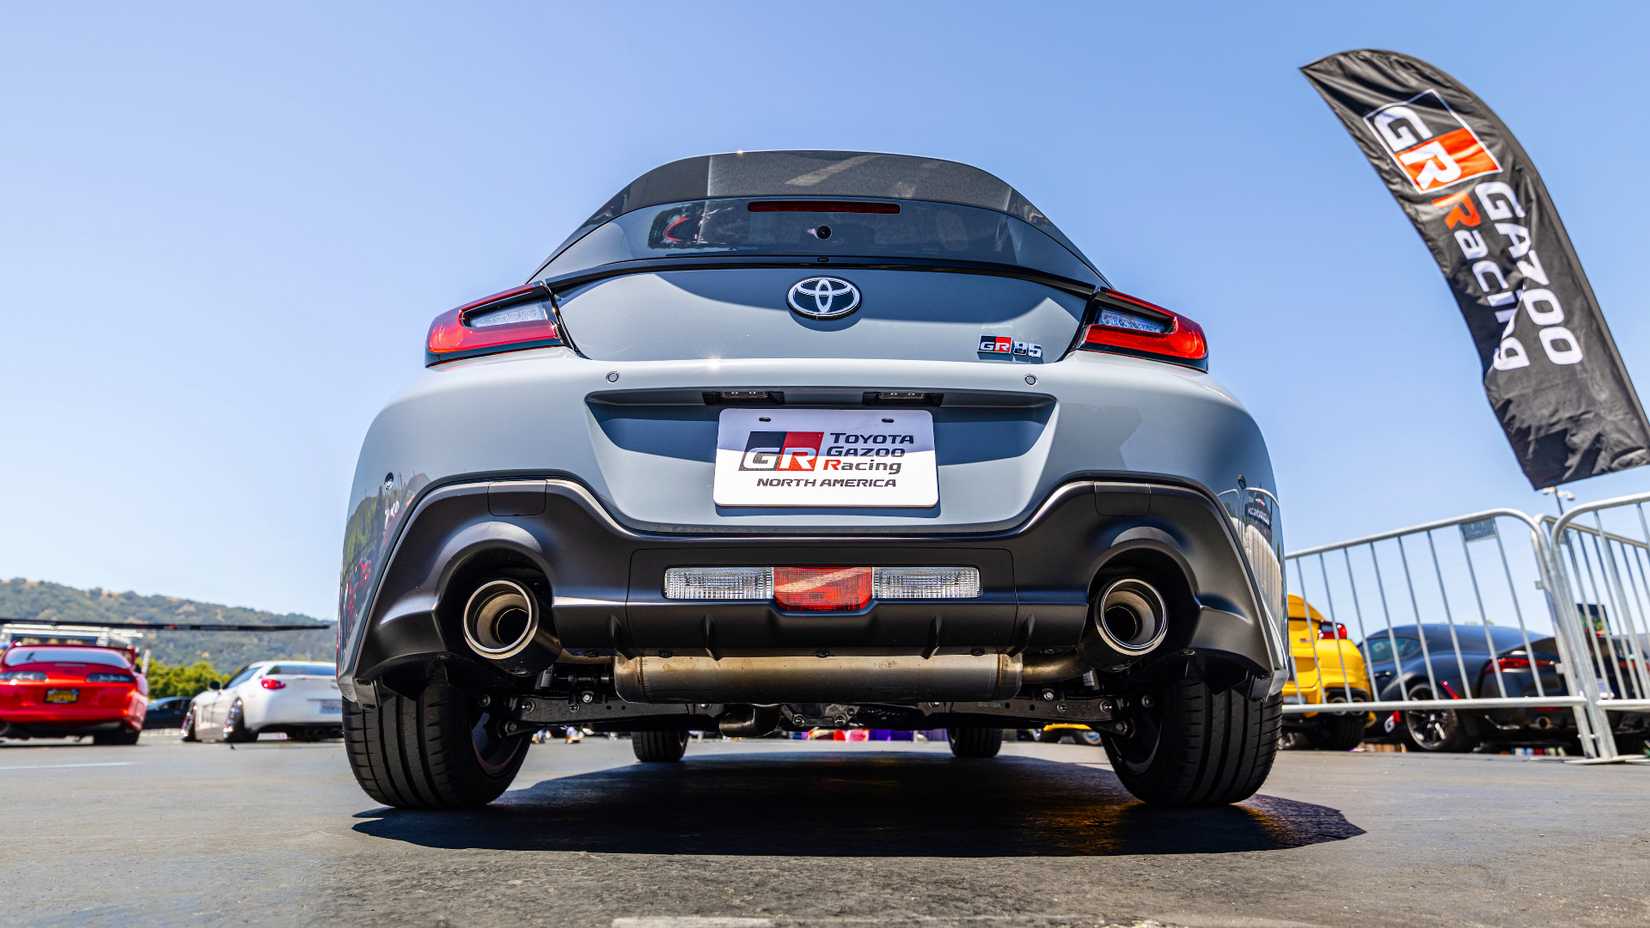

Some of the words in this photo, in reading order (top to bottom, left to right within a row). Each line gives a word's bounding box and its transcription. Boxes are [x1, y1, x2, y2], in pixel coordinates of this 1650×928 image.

[1373, 105, 1462, 189] GR
[1475, 181, 1584, 365] GAZOO
[829, 432, 914, 444] TOYOTA
[743, 447, 817, 471] GR
[826, 446, 906, 458] GAZOO
[823, 459, 902, 475] Racing
[756, 478, 817, 487] NORTH
[819, 478, 897, 488] AMERICA
